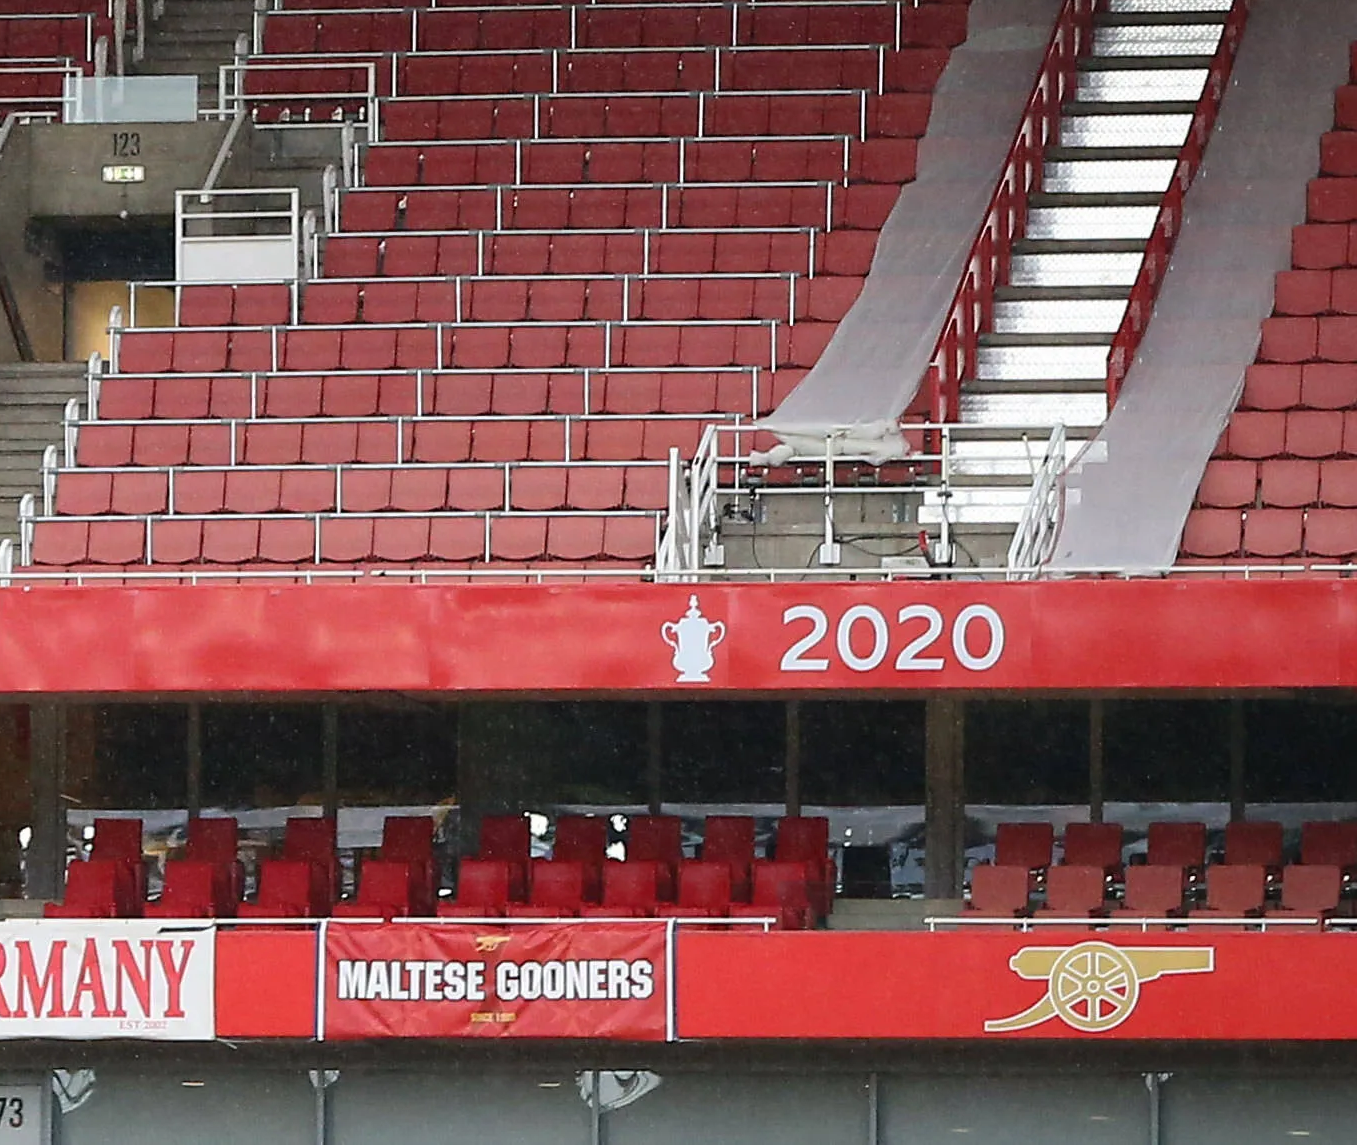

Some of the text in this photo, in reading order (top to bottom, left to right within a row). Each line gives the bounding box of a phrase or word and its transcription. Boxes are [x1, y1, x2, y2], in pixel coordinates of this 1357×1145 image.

[113, 132, 140, 157] 123
[779, 603, 1005, 673] 2020
[338, 960, 654, 1001] MALTESE GOONERS
